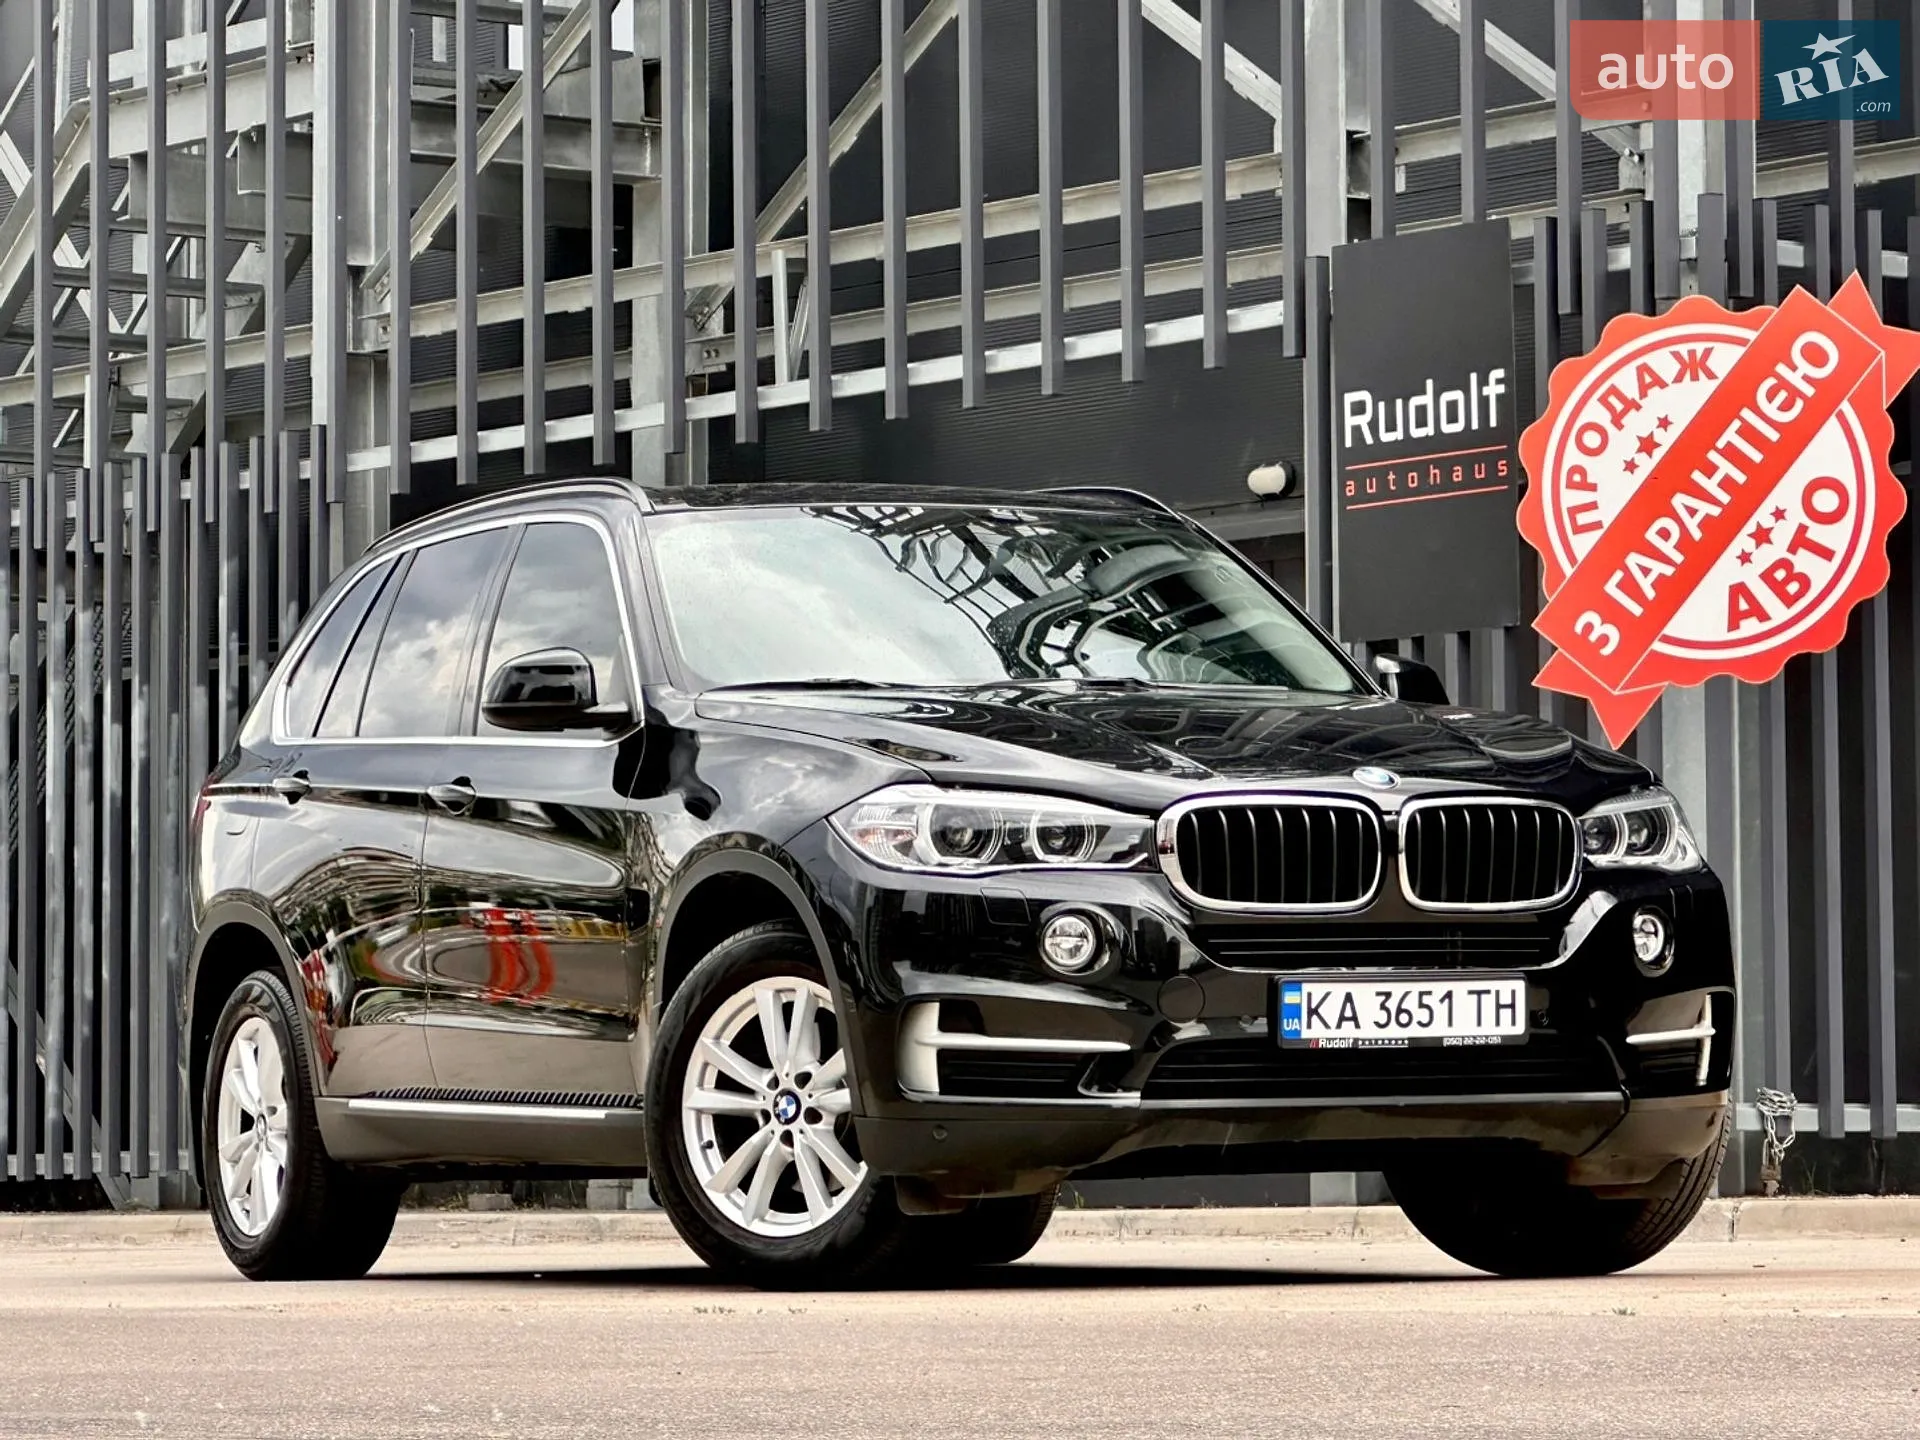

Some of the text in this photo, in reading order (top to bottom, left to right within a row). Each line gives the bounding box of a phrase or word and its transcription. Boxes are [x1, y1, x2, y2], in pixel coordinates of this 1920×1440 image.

[1343, 368, 1505, 448] Rudolf
[1345, 460, 1508, 496] autohaus
[1283, 1018, 1300, 1031] UA
[1305, 988, 1517, 1030] KA 3651 TH
[1318, 1038, 1355, 1048] Rudolf
